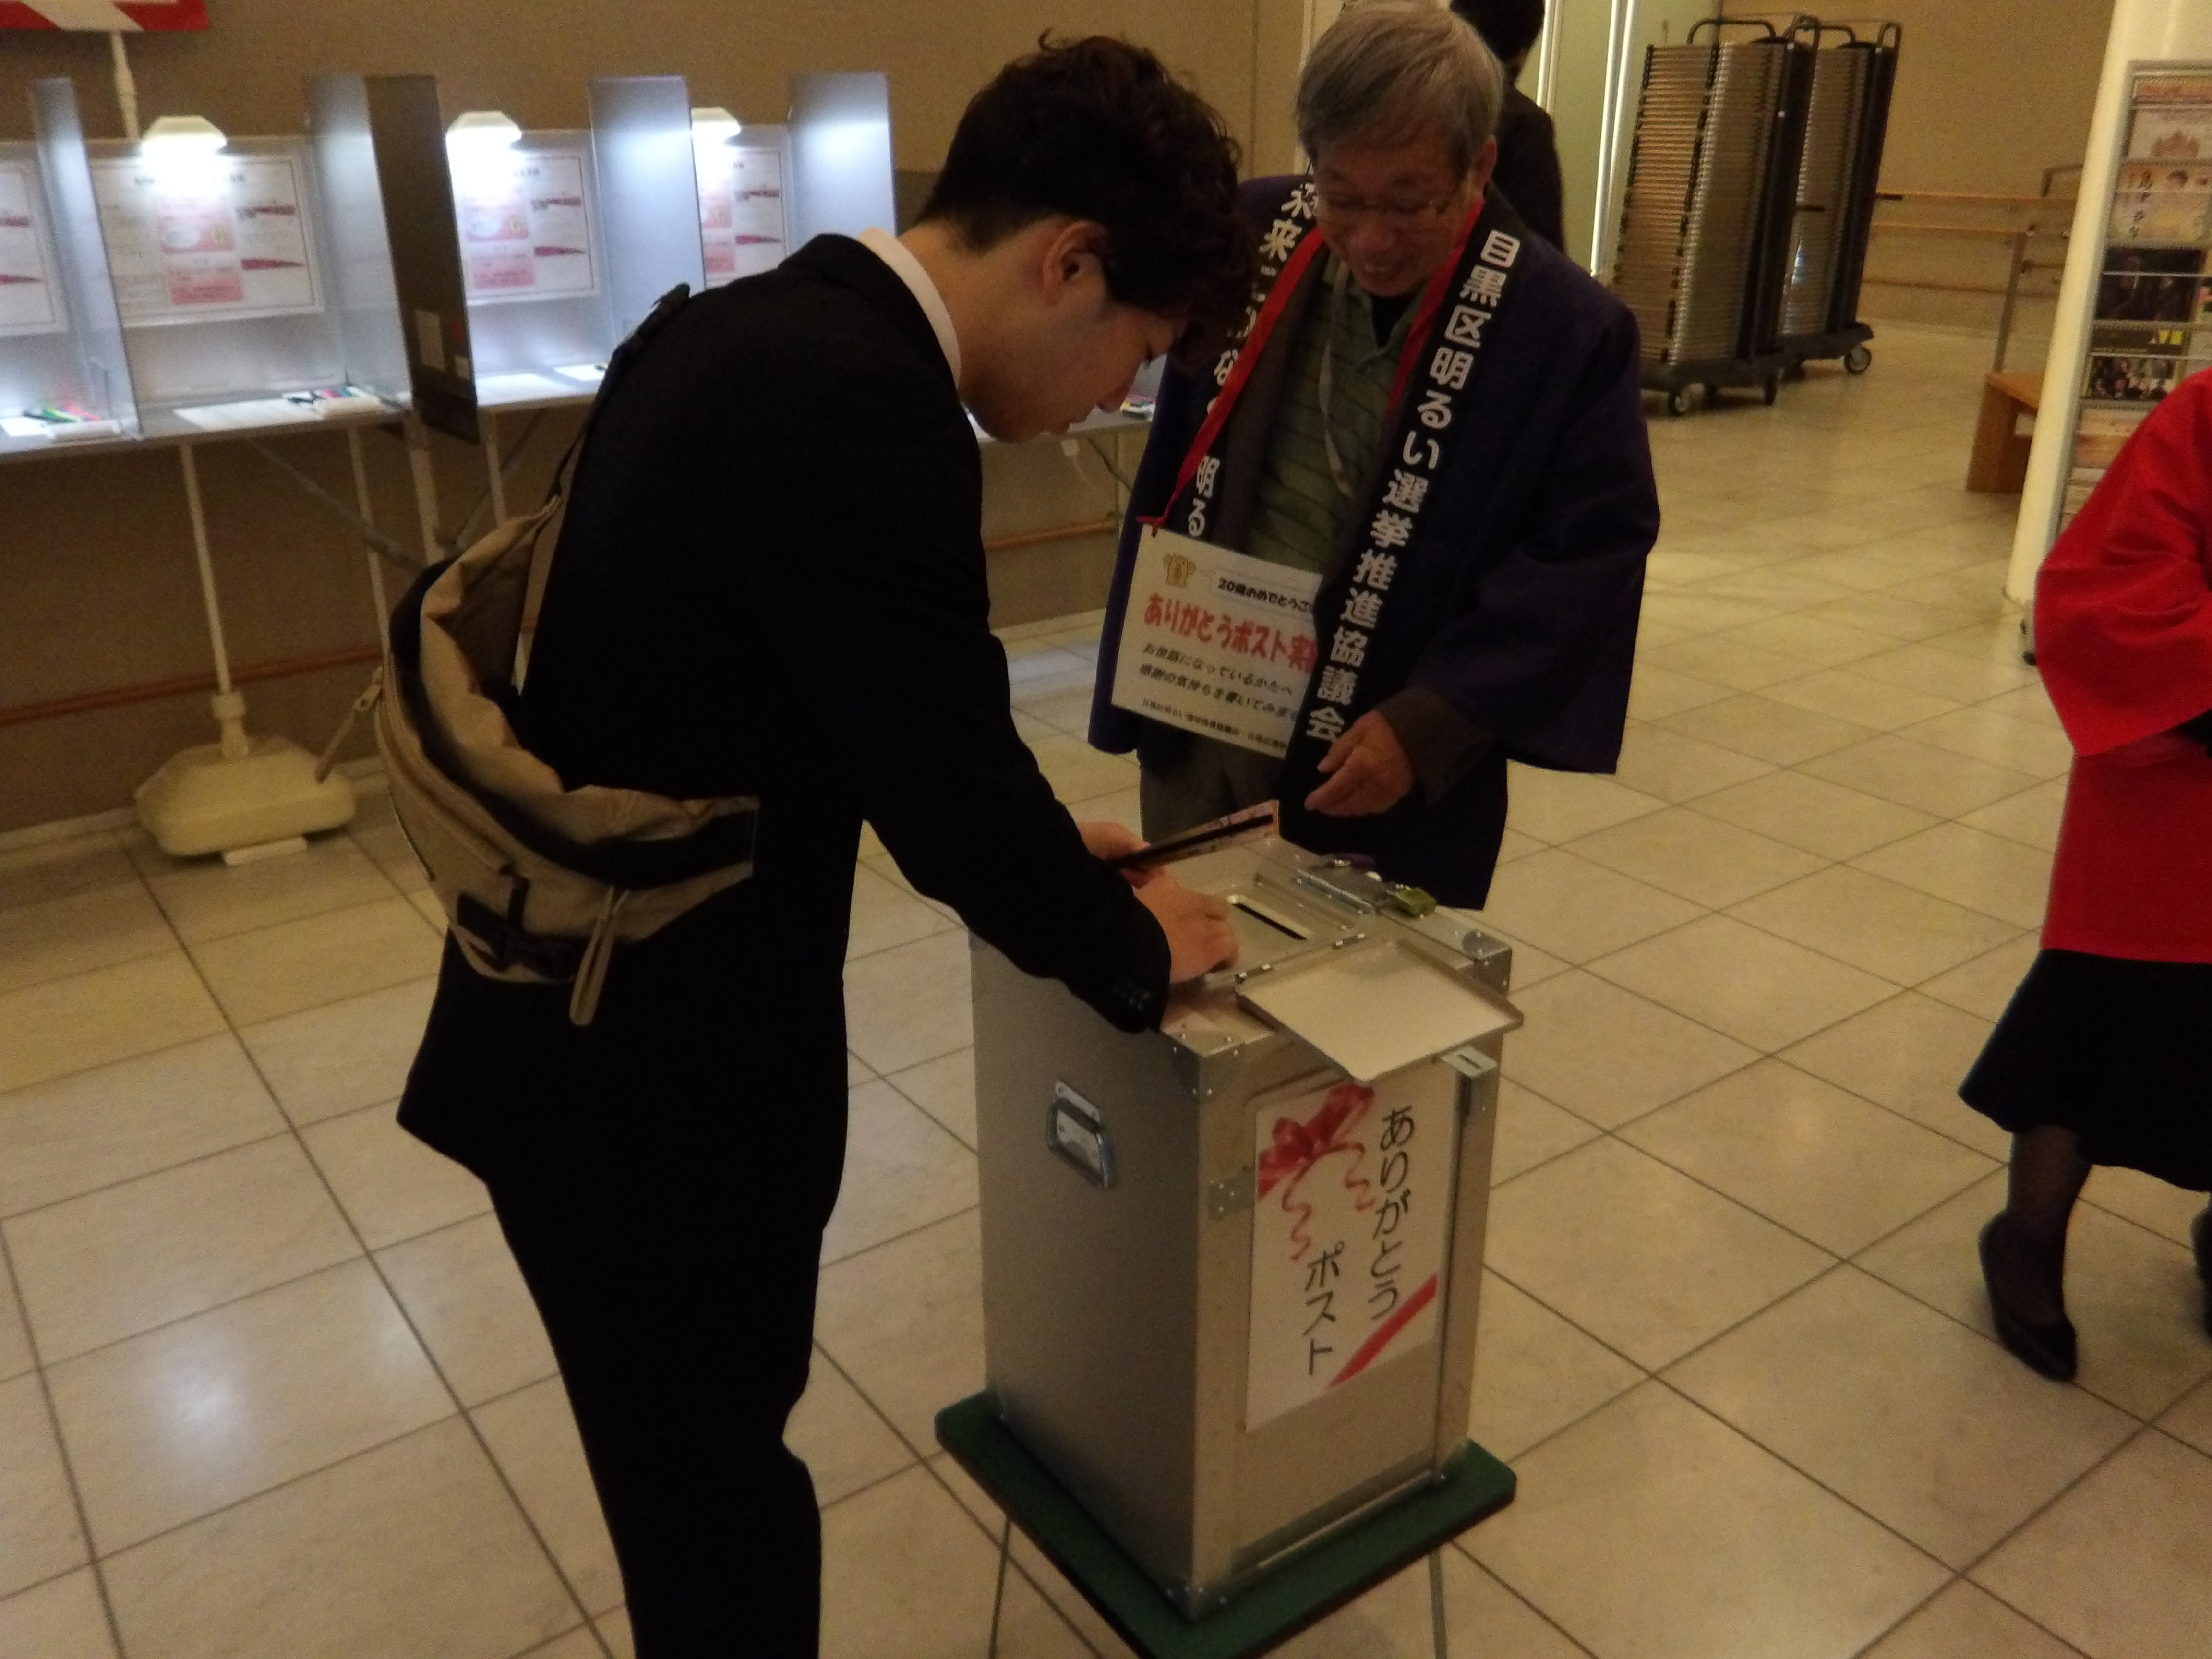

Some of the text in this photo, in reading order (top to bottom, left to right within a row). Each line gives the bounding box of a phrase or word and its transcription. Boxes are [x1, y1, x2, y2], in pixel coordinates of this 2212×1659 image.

[1306, 229, 1520, 742] 目黒区明るい選挙推進協議会
[1302, 1241, 1345, 1375] ポスト
[1367, 1105, 1415, 1321] ありがとう
